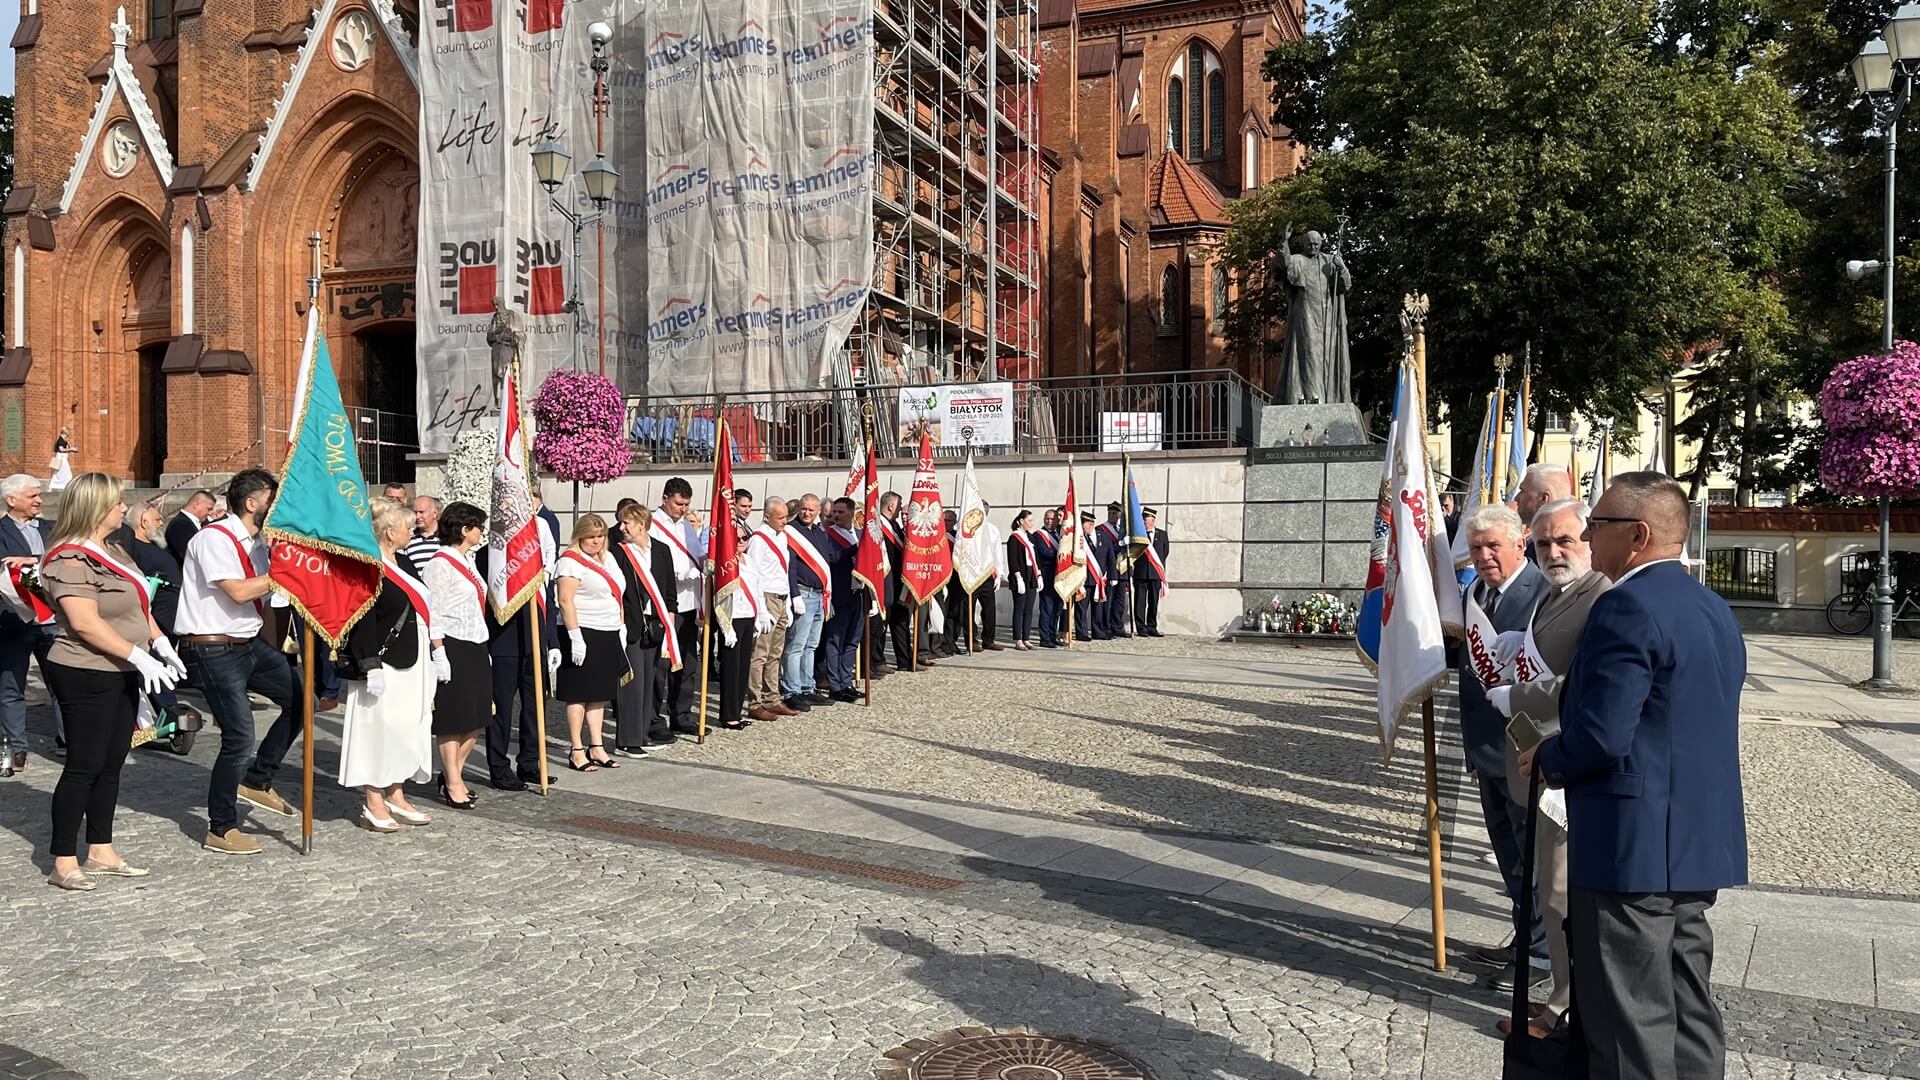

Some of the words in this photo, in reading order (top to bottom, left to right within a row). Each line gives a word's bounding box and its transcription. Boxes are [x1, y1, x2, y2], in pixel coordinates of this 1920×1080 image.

[437, 100, 500, 165] Life
[438, 323, 491, 335] baumit.co
[950, 404, 1003, 414] BIAŁYSTOK
